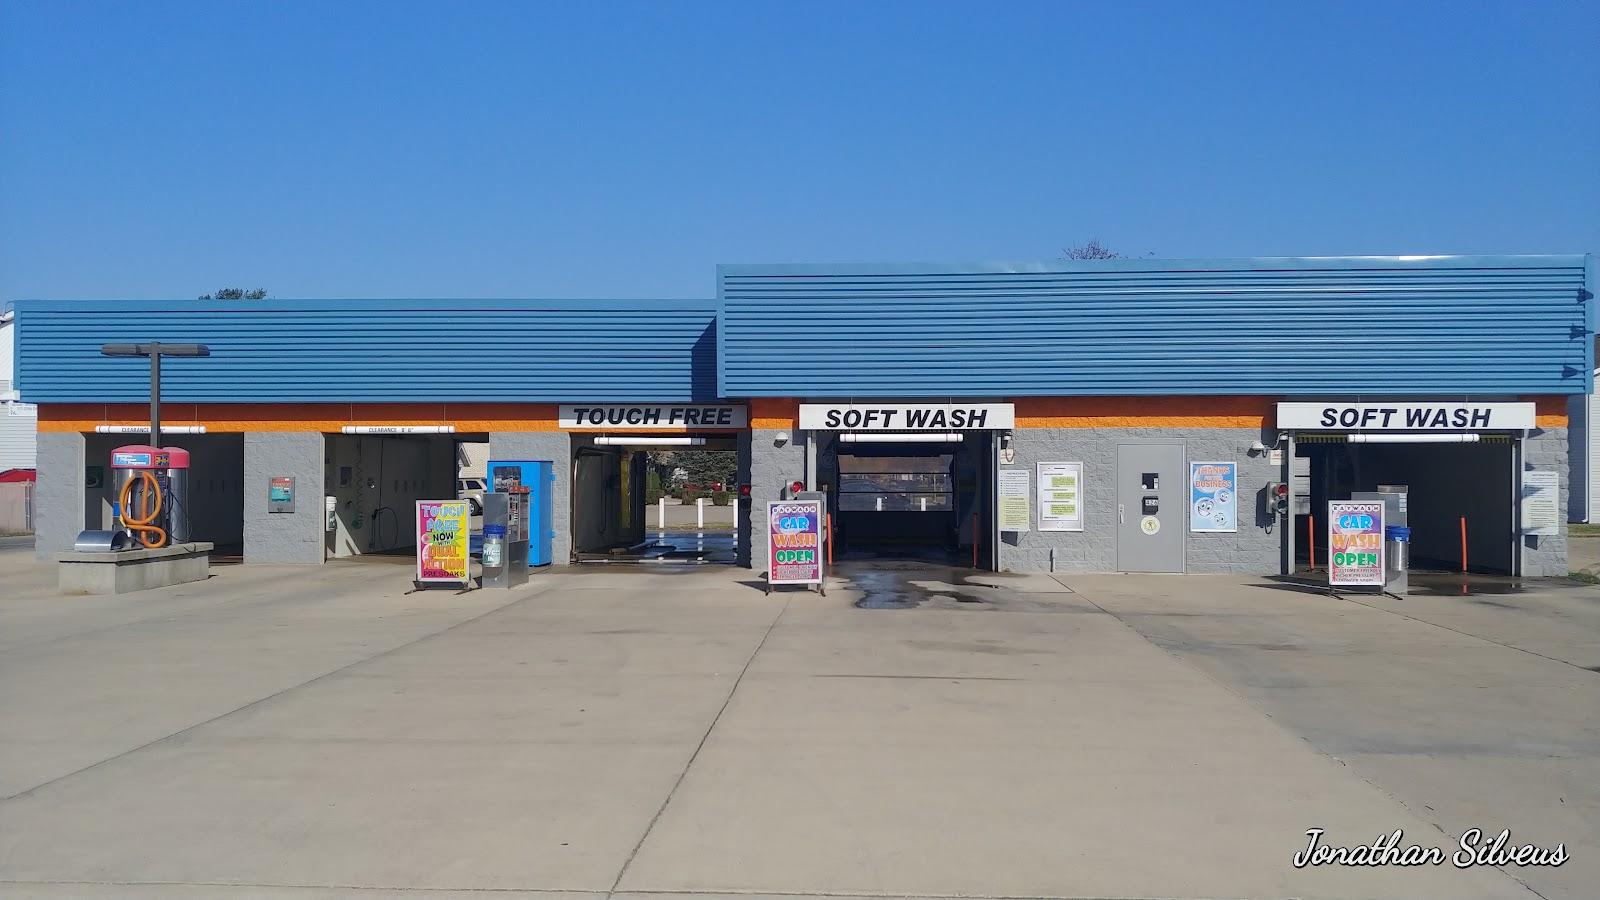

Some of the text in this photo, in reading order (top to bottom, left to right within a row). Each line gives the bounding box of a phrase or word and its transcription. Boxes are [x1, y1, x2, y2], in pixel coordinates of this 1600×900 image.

[573, 408, 733, 425] TOUCH FREE
[824, 409, 988, 428] SOFT WASH
[1320, 408, 1492, 428] SOFT WASH
[1195, 480, 1232, 488] BUSINESS
[421, 504, 464, 518] TOUCH
[426, 518, 459, 532] FREE
[780, 517, 810, 530] CAR
[1338, 514, 1373, 530] CAR
[433, 532, 453, 541] NOW
[772, 533, 818, 548] WASH
[1332, 533, 1380, 549] WASH
[428, 545, 459, 558] DUAL
[776, 550, 814, 564] OPEN
[423, 558, 465, 570] ACTION
[1333, 551, 1377, 567] OPEN
[423, 570, 466, 578] PRESOAKS
